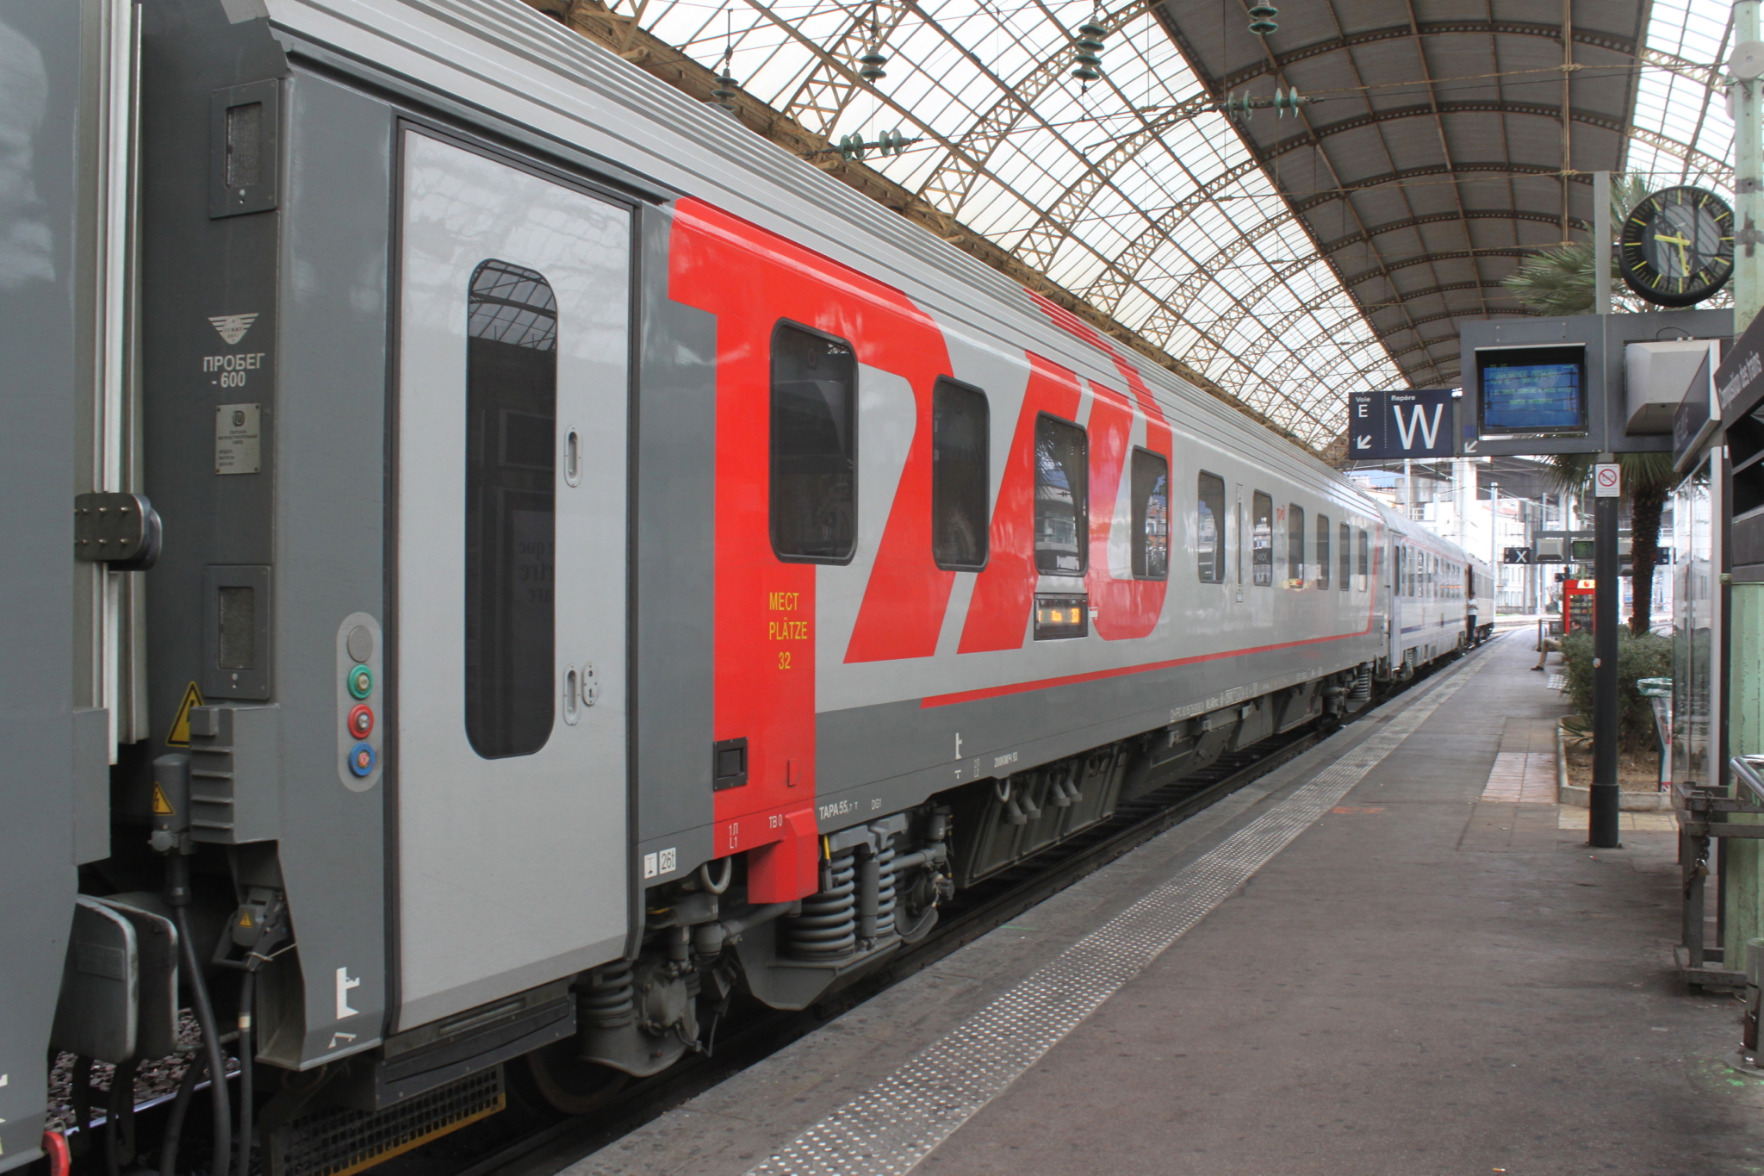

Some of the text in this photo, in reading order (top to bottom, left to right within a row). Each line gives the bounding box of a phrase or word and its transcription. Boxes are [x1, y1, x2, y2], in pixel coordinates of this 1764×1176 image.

[203, 353, 265, 372] ПРОБЕГ
[1739, 363, 1750, 389] des
[1745, 350, 1763, 382] trains
[221, 371, 245, 388] 600
[1356, 395, 1371, 403] Voie
[1358, 404, 1368, 418] E
[1393, 403, 1444, 450] W
[1515, 550, 1527, 563] X
[769, 592, 799, 610] МЕСТ
[769, 617, 808, 640] PLÄTZE
[778, 651, 791, 669] 32
